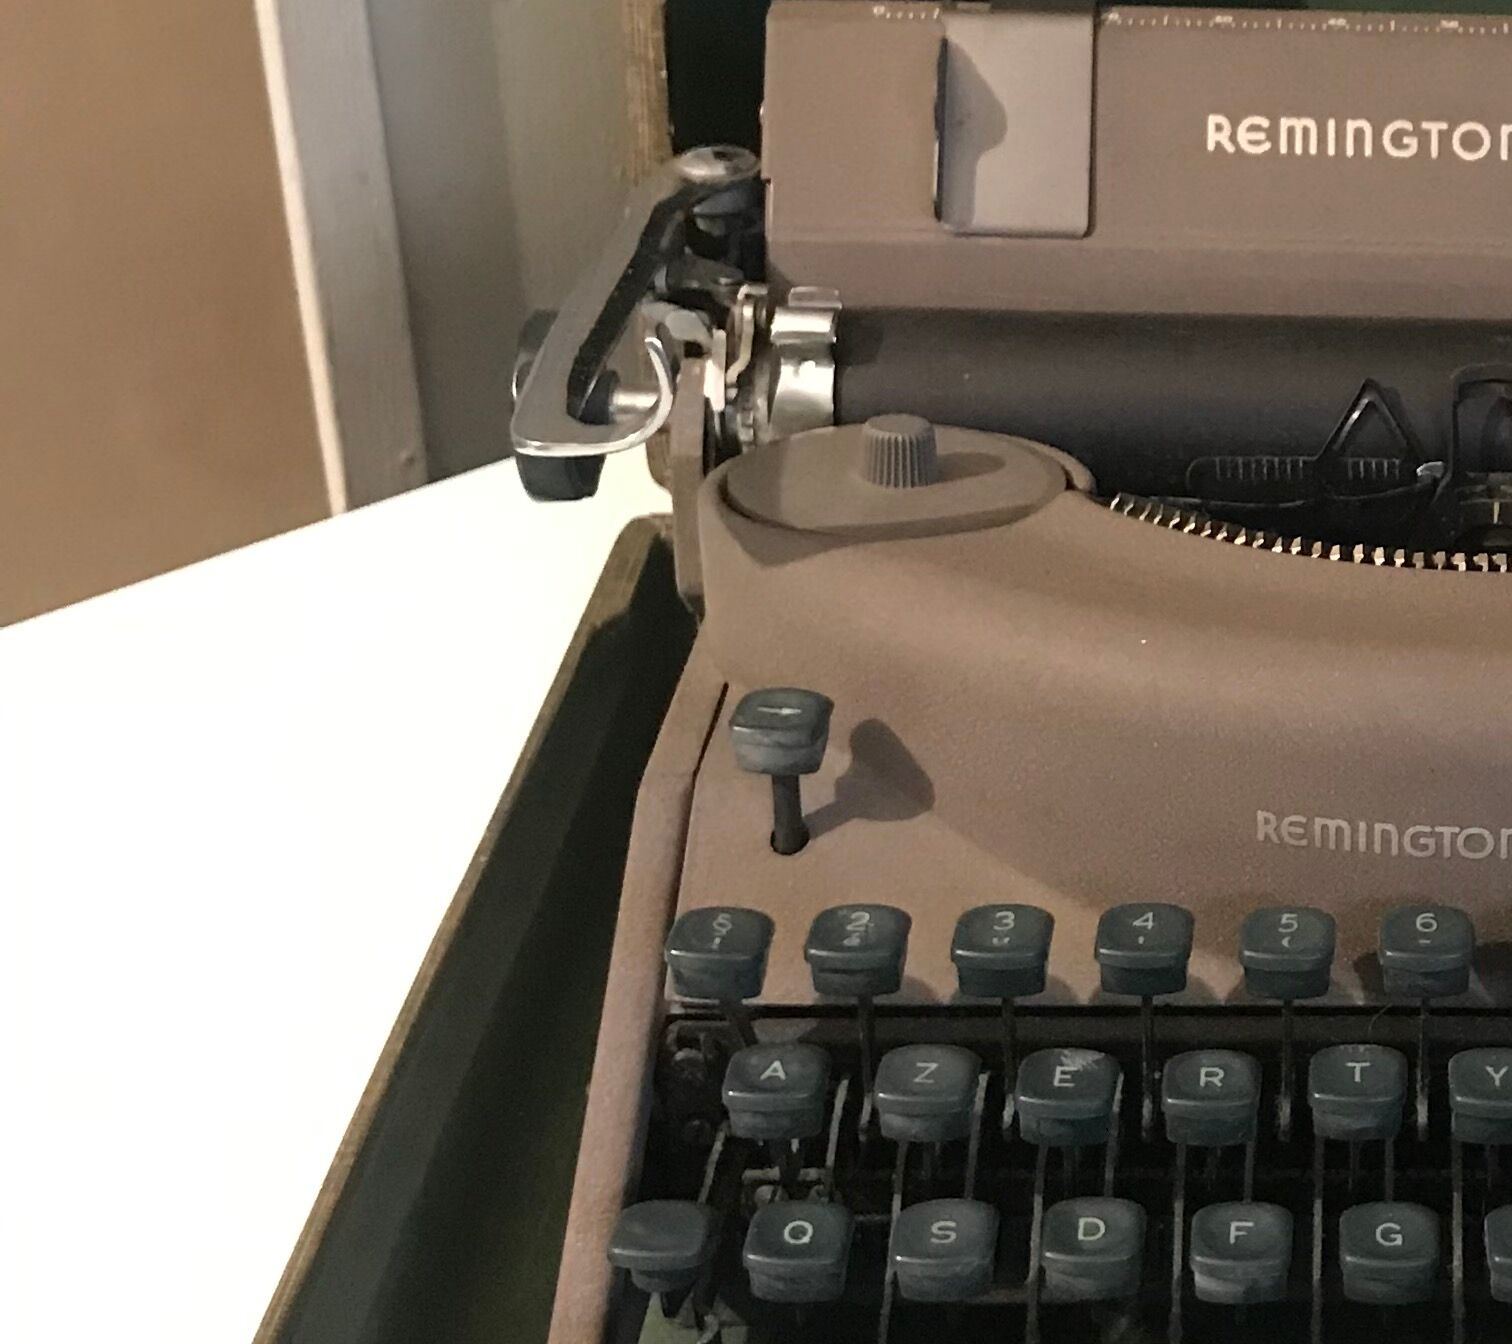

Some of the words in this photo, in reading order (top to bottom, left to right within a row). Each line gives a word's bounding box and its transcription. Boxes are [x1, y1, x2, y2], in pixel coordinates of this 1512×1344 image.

[846, 910, 871, 932] 2
[992, 910, 1016, 931] 3
[1131, 911, 1155, 931] 4
[1277, 913, 1299, 933] 5
[1414, 912, 1438, 933] 6
[758, 1061, 788, 1081] A
[913, 1062, 939, 1084] Z
[1053, 1066, 1078, 1087] E
[1199, 1067, 1225, 1087] R
[1345, 1062, 1371, 1083] T
[1485, 1065, 1509, 1086] Y
[783, 1220, 814, 1244] Q
[929, 1220, 958, 1244] S
[1077, 1216, 1106, 1241] D
[1229, 1221, 1254, 1244] F
[1375, 1222, 1403, 1247] G
